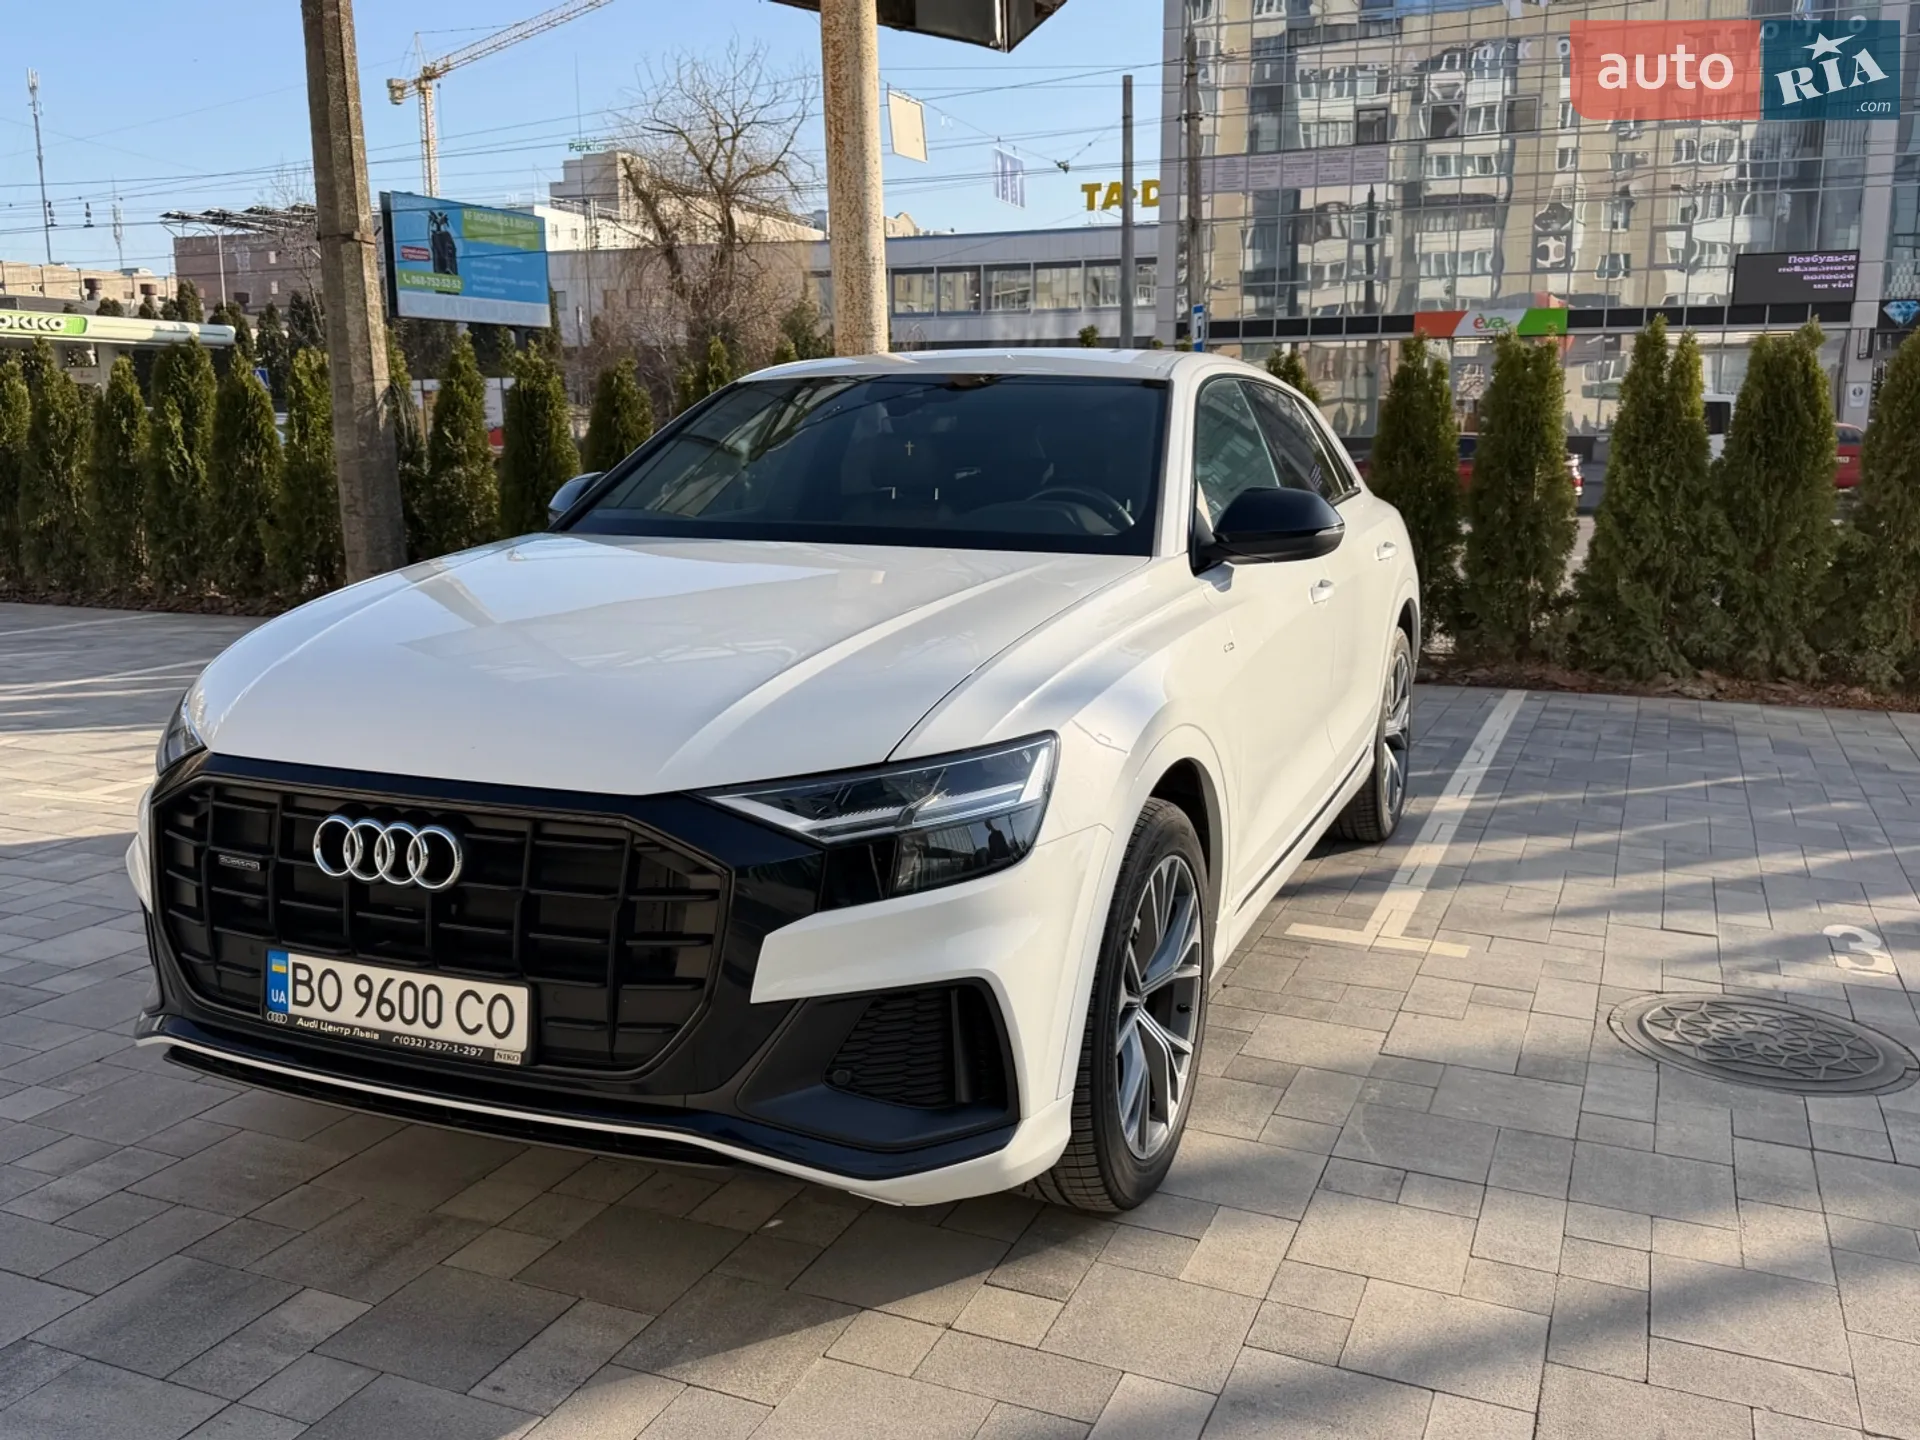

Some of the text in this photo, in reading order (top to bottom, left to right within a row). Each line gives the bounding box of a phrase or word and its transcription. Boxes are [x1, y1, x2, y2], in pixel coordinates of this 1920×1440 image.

[1822, 924, 1895, 977] 3
[271, 989, 286, 1004] UA
[292, 962, 515, 1039] BO 9600 CO
[296, 1018, 380, 1039] Audi Центр Львів
[400, 1036, 483, 1057] (032) 297-1-297
[495, 1052, 520, 1063] NIKO
